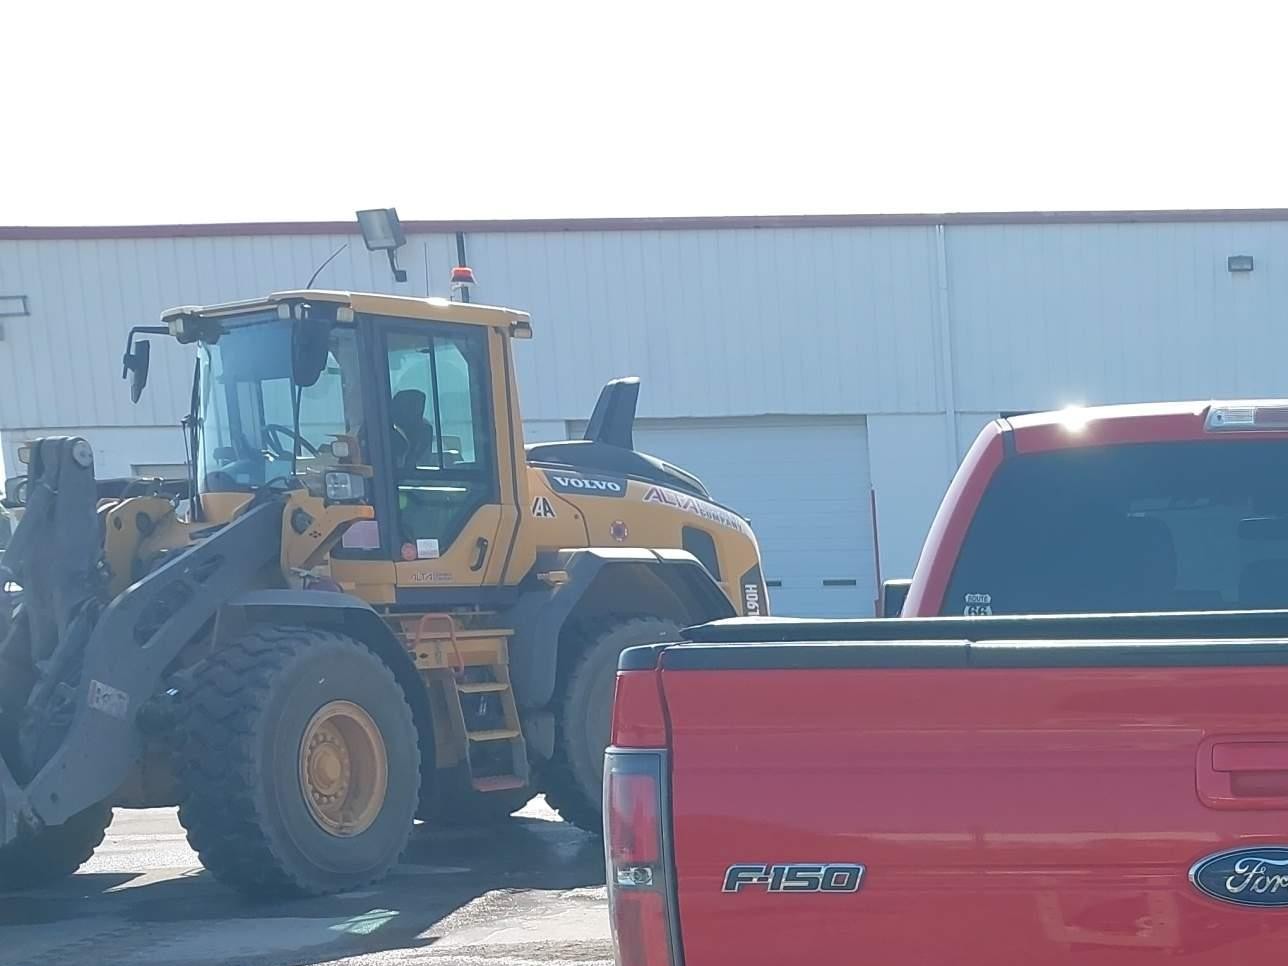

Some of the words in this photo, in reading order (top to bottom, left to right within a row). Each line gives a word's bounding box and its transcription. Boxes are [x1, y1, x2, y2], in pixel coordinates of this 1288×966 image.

[554, 476, 621, 492] VOLVO
[643, 486, 701, 515] ALTA
[721, 863, 866, 893] F-150
